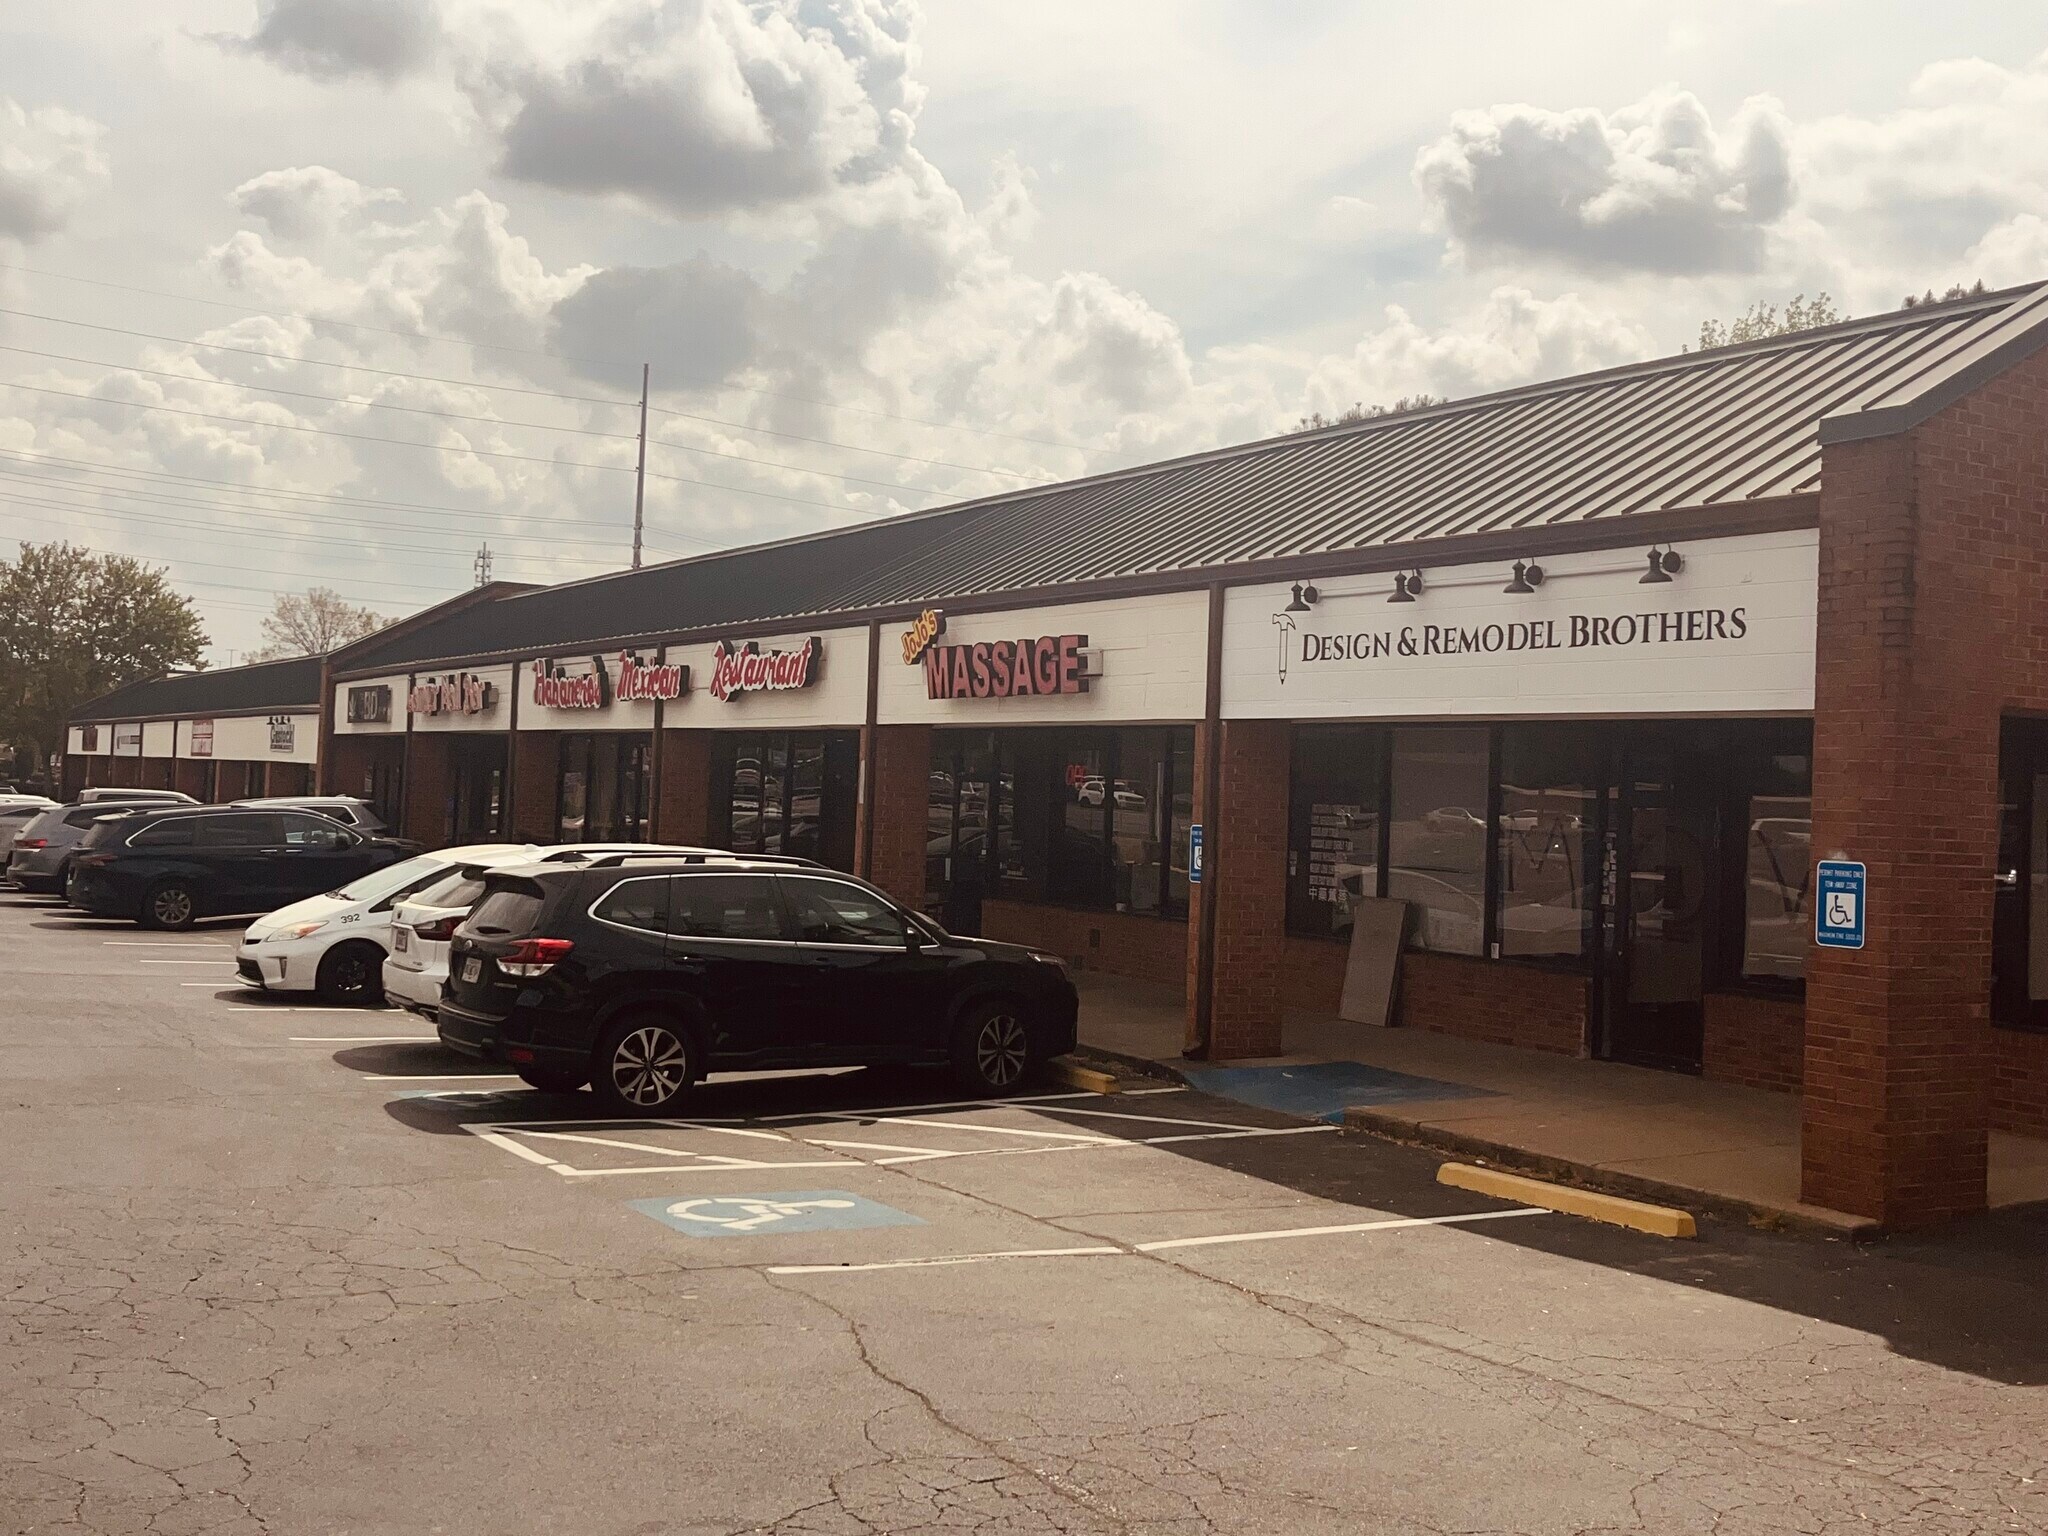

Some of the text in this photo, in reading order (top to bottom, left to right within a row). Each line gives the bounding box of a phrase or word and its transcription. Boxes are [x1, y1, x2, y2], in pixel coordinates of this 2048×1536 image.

[1397, 627, 1418, 657] &
[616, 648, 683, 702] Mexican
[710, 638, 814, 703] Restaurant
[926, 635, 1085, 700] MASSAGE
[340, 914, 360, 923] 392
